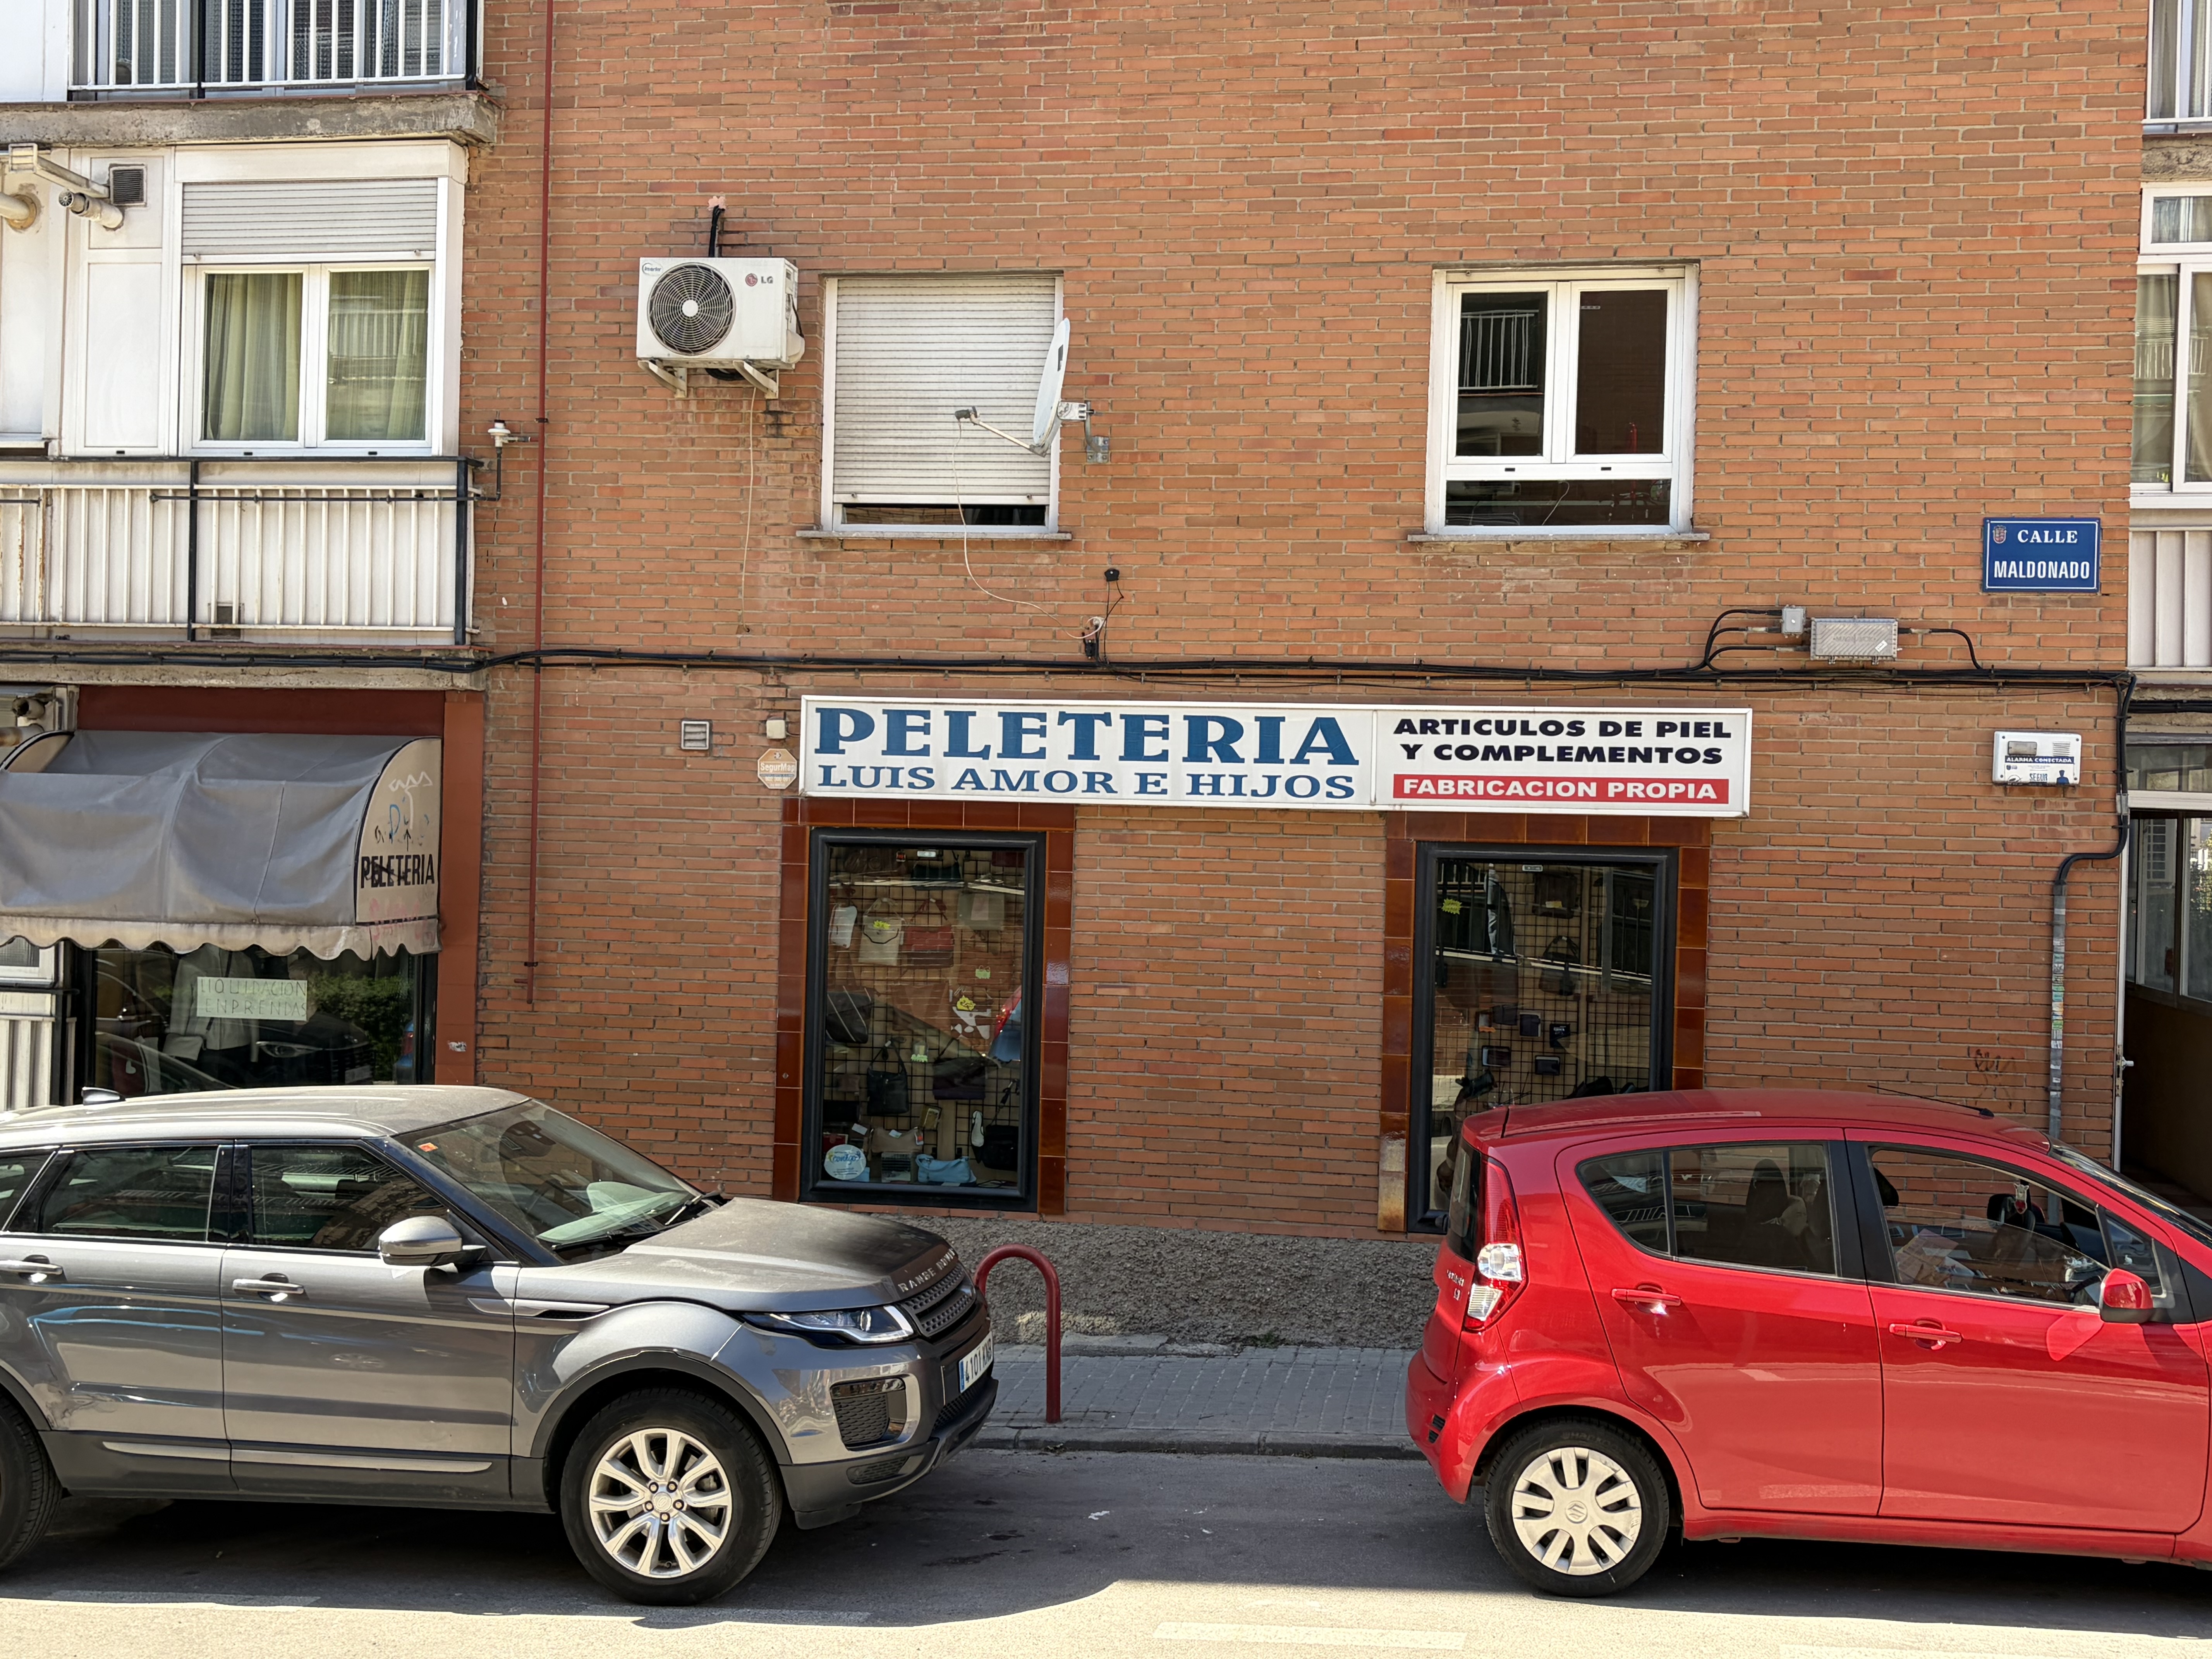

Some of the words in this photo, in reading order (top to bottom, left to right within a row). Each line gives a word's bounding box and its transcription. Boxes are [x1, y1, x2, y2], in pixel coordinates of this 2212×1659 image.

[2017, 530, 2078, 544] CALLE
[1994, 560, 2090, 579] MALDONADO
[814, 707, 1359, 765] PELETERIA
[1393, 719, 1585, 737] ARTICULOS
[1599, 721, 1642, 737] DE
[1656, 721, 1731, 738] PIEL
[1400, 744, 1423, 760] Y
[1434, 744, 1723, 764] COMPLEMENTOS
[760, 763, 795, 773] SegurMap
[818, 764, 935, 790] LUIS
[951, 768, 1118, 794] AMOR
[1134, 772, 1168, 795] E
[1186, 773, 1355, 799] HIJOS
[1403, 779, 1597, 797] FABRICACION
[1608, 782, 1717, 799] PROPIA
[361, 854, 435, 889] PELETERIA
[201, 979, 306, 996] LIQUIDACION
[898, 1267, 936, 1292] RANGE
